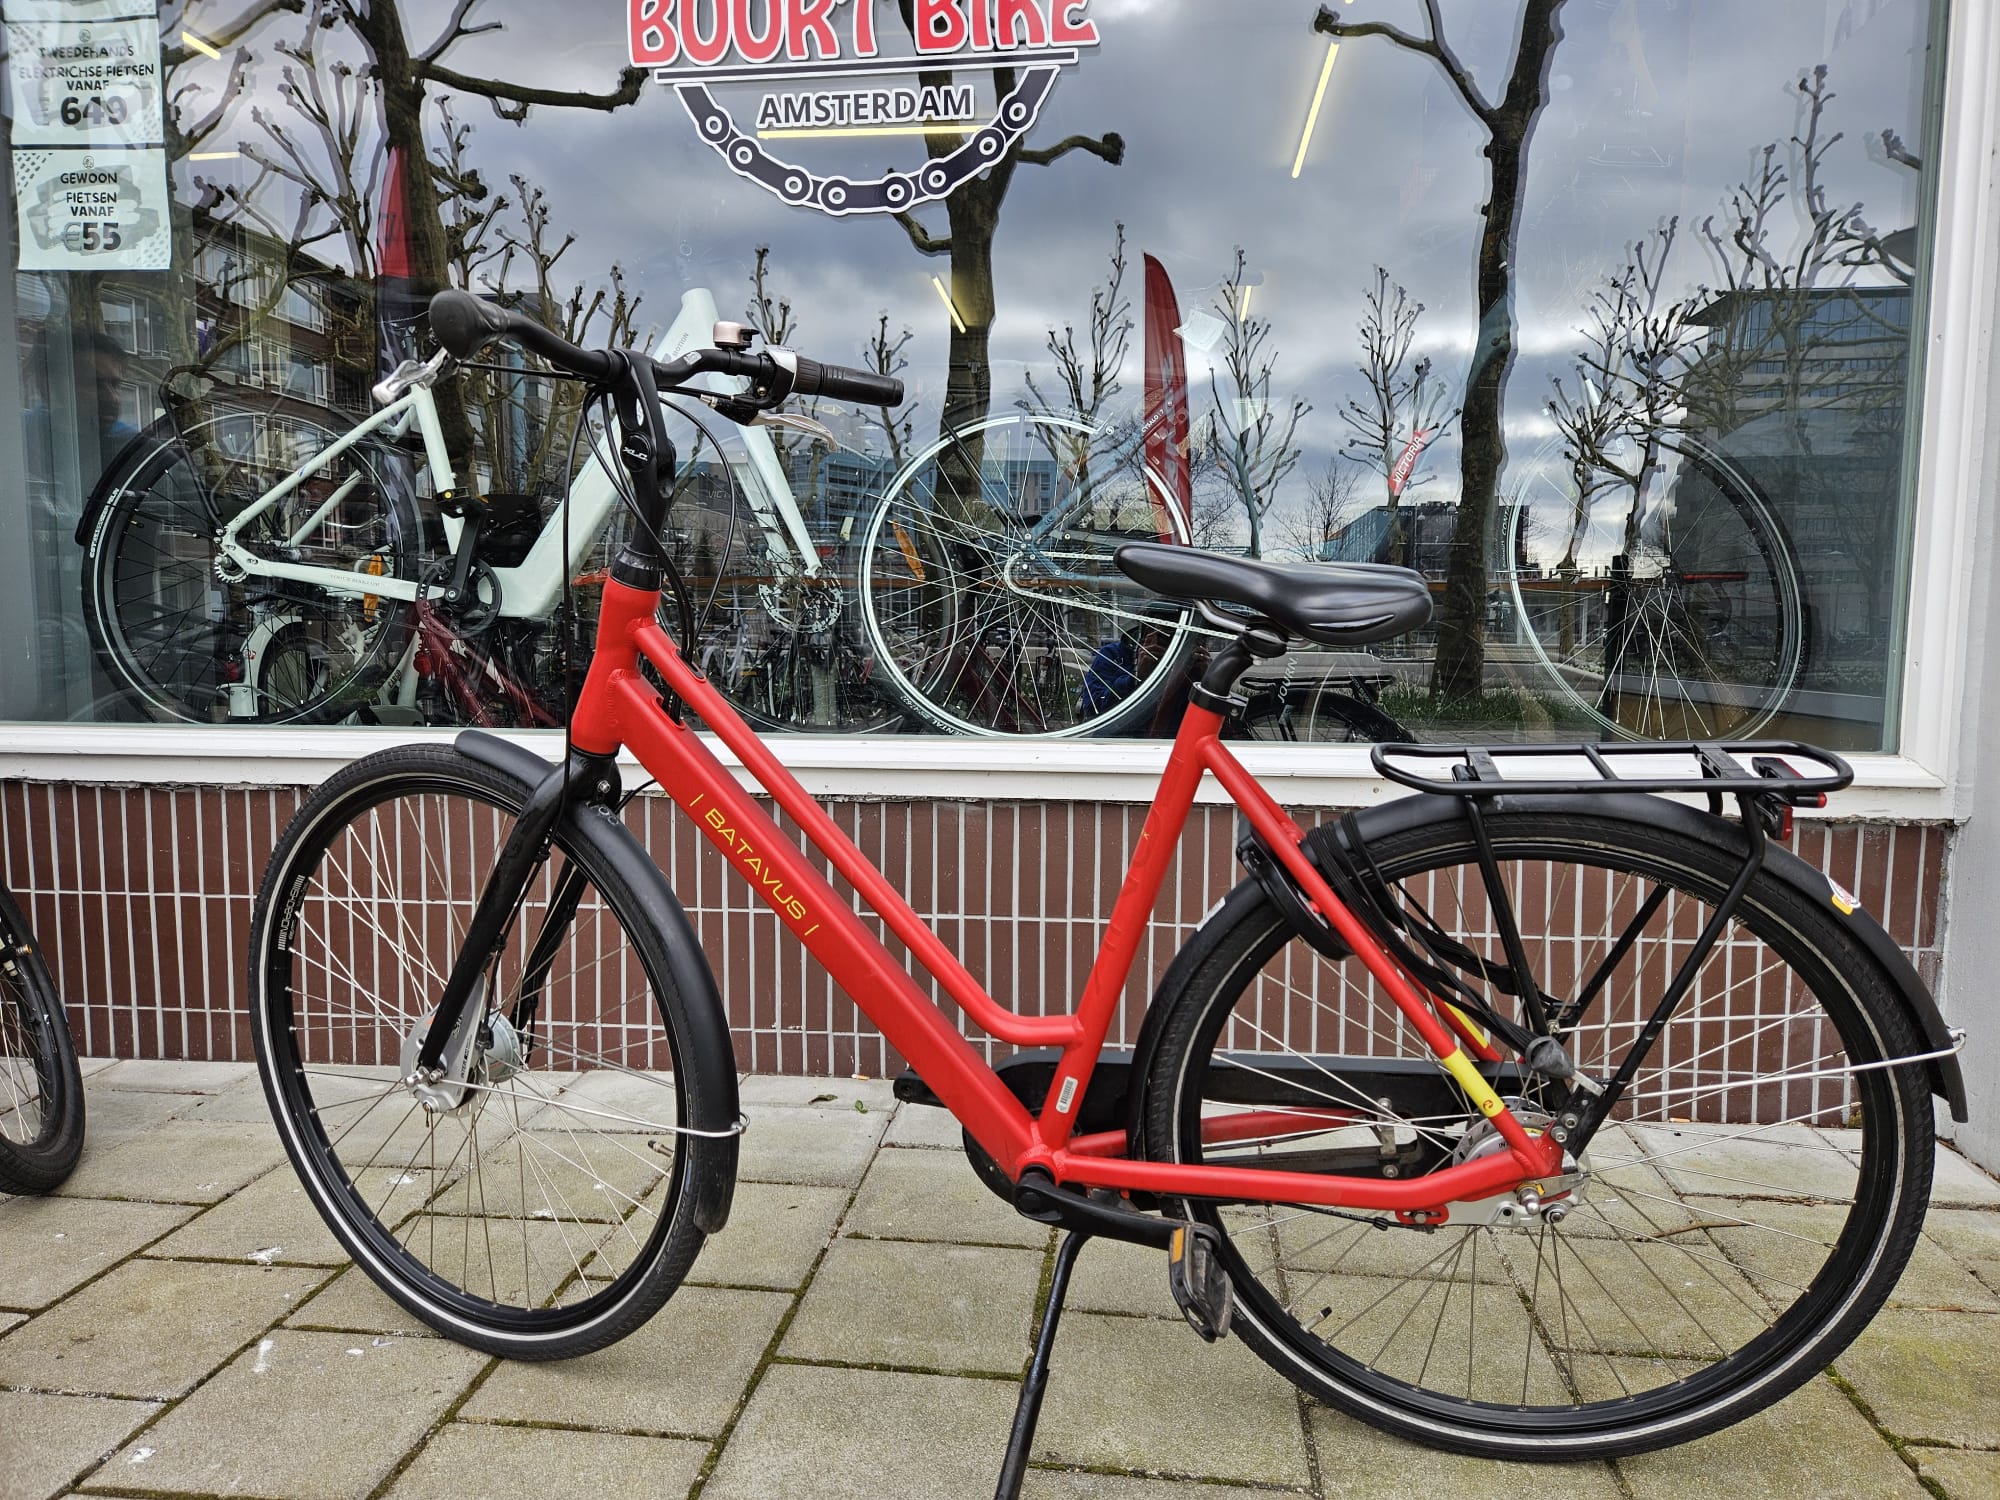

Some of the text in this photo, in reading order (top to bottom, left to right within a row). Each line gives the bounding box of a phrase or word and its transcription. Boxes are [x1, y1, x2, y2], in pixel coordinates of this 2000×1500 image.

[39, 45, 134, 59] TWEEDEHANDS
[106, 63, 154, 77] FIETSEN
[66, 80, 110, 91] VANAF
[758, 87, 972, 126] AMSTERDAM
[60, 172, 118, 185] GEWOON
[66, 192, 117, 204] FIETSEN
[70, 206, 115, 217] VANAF
[1392, 436, 1423, 484] VICTORIA
[704, 807, 807, 921] BATAVUS
